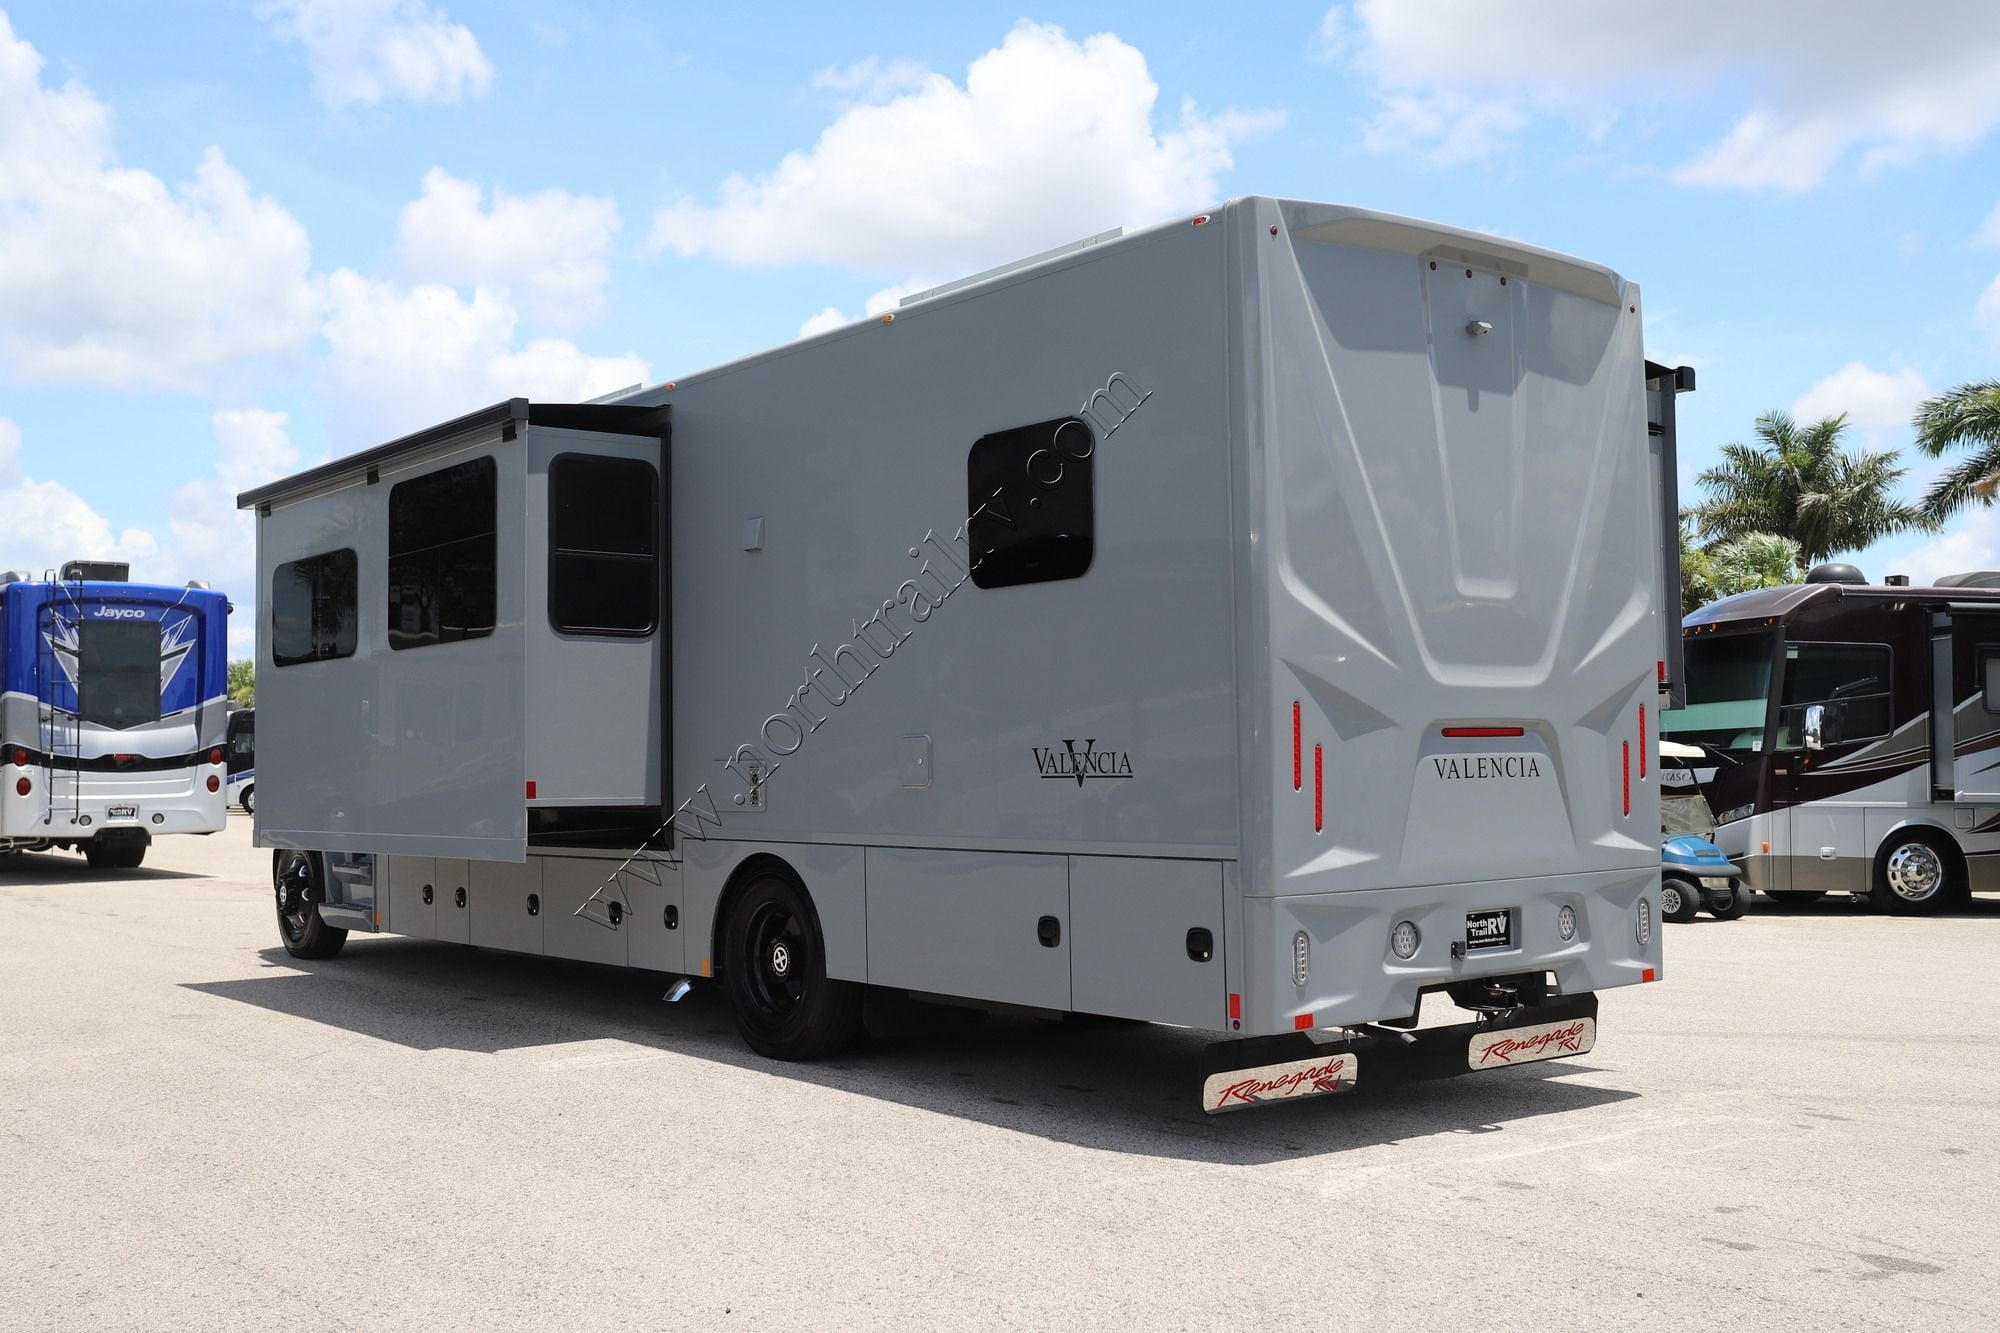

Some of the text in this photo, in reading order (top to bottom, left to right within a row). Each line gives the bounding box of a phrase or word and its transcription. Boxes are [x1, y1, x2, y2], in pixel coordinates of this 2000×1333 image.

[93, 605, 146, 620] Jayco
[1032, 747, 1133, 774] VALENCIA
[1433, 757, 1540, 779] VALENCIA
[1662, 771, 1692, 783] ITASC
[1466, 915, 1508, 935] North RV
[1470, 927, 1488, 937] Trail
[1480, 1021, 1585, 1064] Renegade
[1557, 1036, 1582, 1052] RV
[1217, 1058, 1344, 1107] Renegade
[1311, 1074, 1342, 1092] RV
